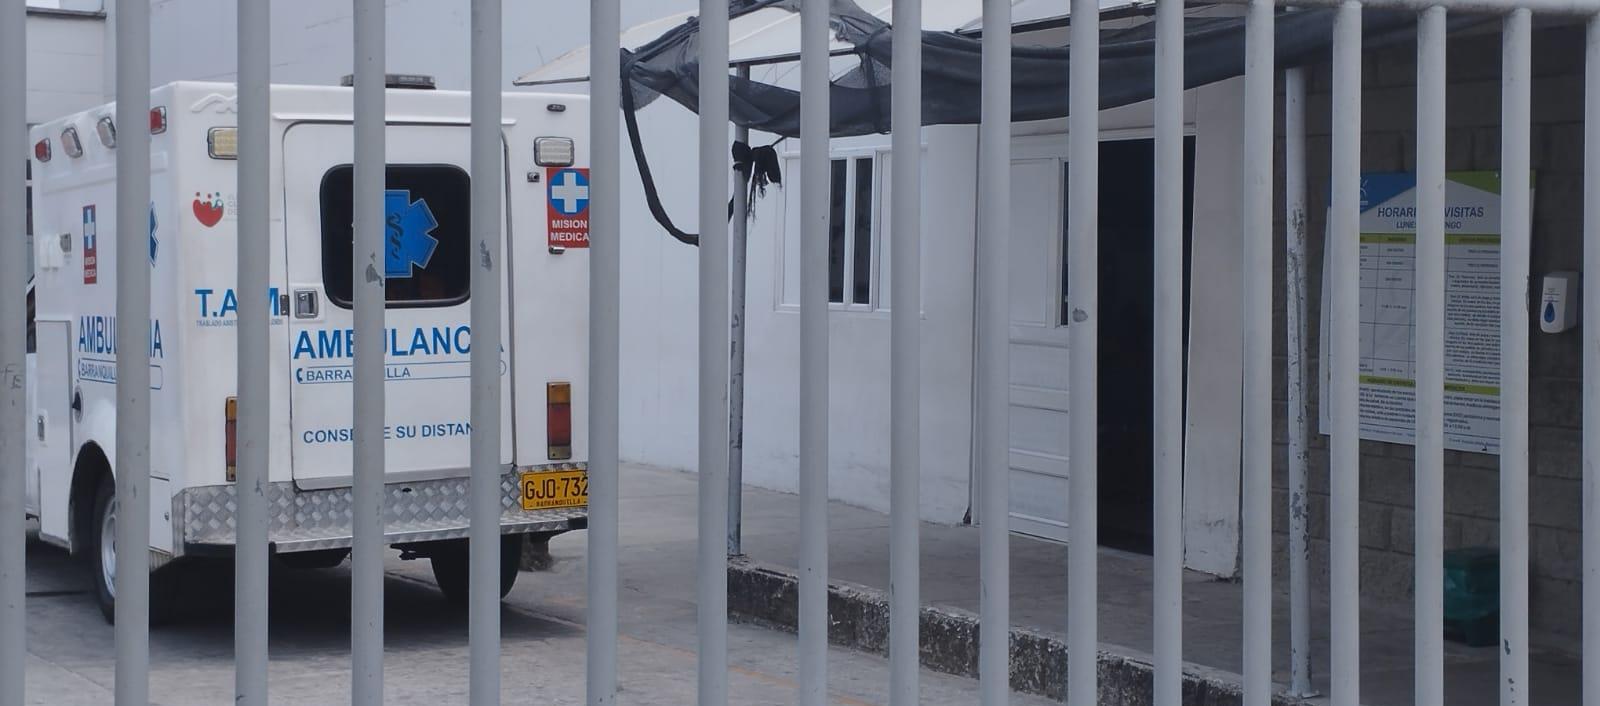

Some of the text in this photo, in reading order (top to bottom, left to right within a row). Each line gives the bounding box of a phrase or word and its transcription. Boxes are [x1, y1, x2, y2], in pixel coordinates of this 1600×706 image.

[1377, 206, 1484, 218] HORARI VISITAS
[551, 219, 588, 229] MISION
[1396, 221, 1416, 229] LUNE
[550, 232, 590, 242] MEDICA
[195, 287, 279, 317] T.A
[78, 315, 163, 358] AMBULIA
[293, 325, 504, 360] AMLANC
[80, 362, 116, 380] BARRANQUIL
[306, 367, 411, 381] BARRALLA
[303, 422, 473, 444] CONSE SU DISTAN
